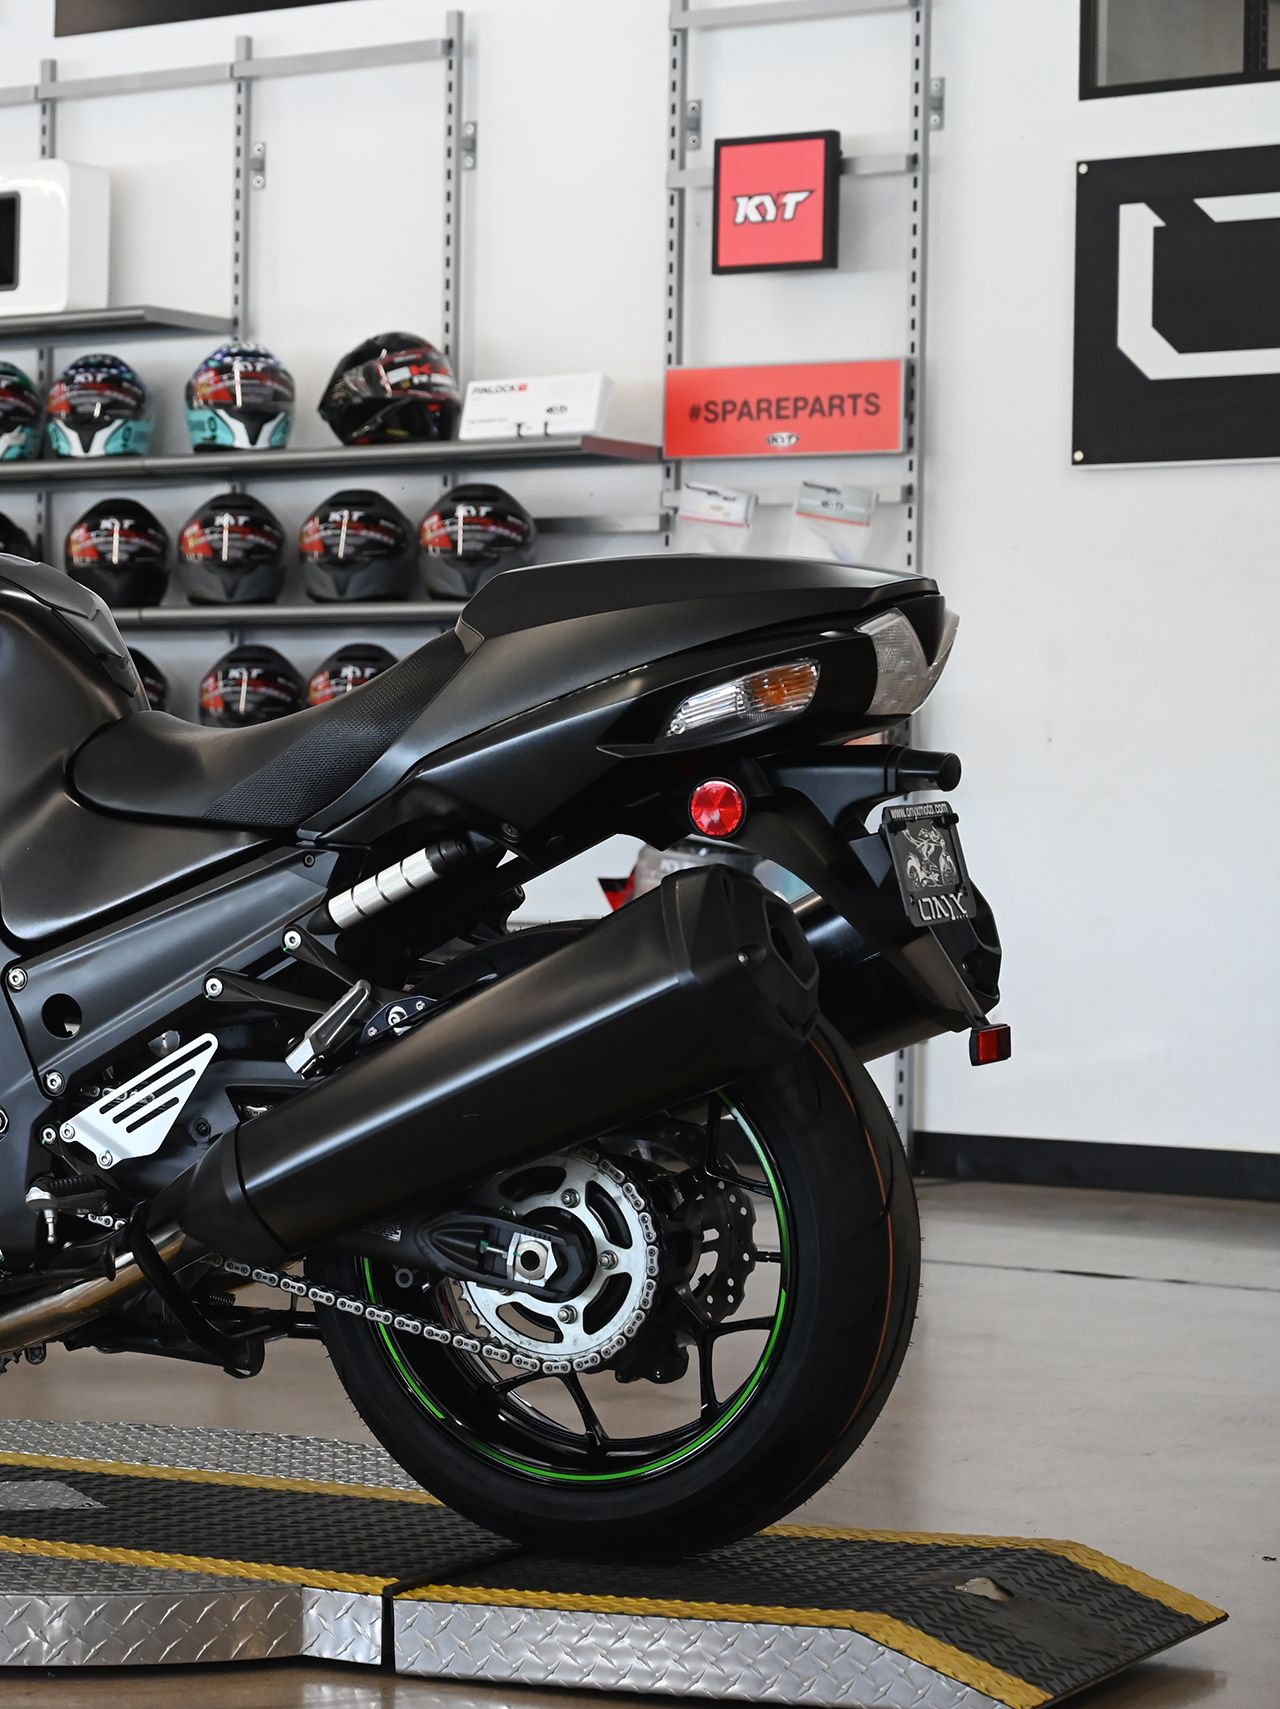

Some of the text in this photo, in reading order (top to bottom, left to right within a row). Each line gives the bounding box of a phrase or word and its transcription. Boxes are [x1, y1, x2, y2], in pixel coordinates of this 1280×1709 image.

[733, 189, 816, 225] KYT
[689, 392, 881, 423] #SPAREPARTS
[918, 892, 968, 921] ONYX
